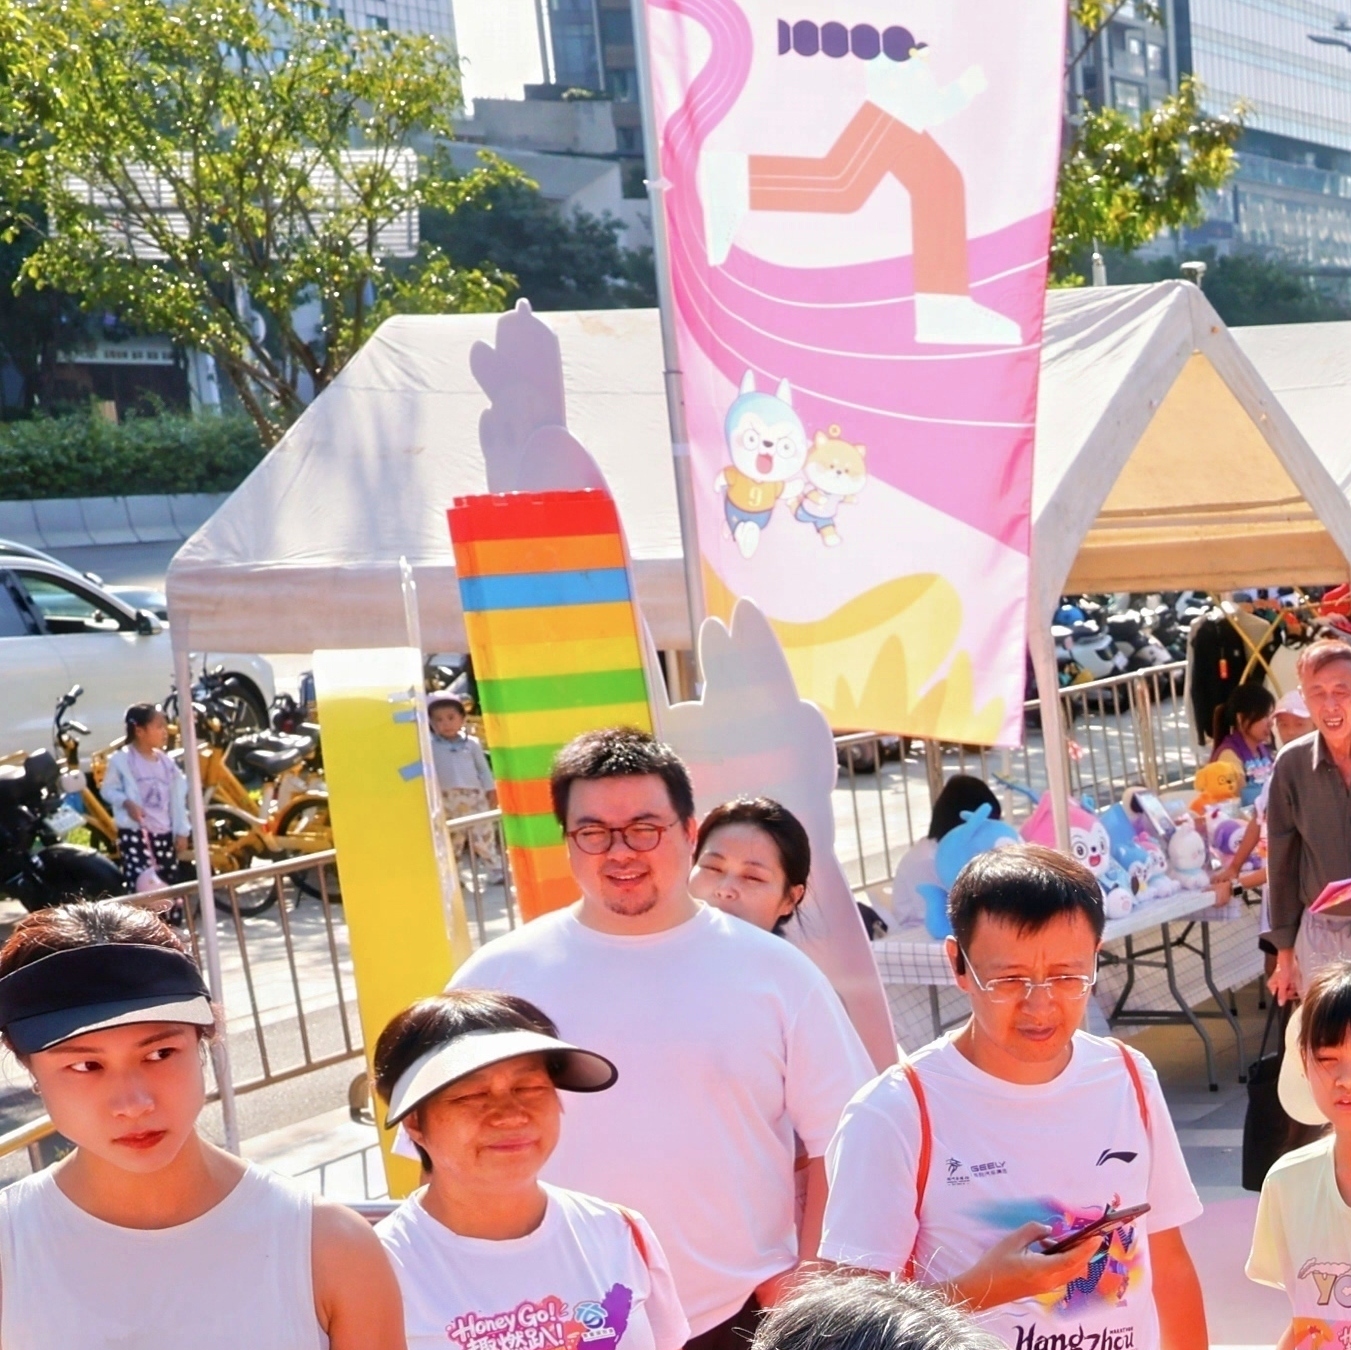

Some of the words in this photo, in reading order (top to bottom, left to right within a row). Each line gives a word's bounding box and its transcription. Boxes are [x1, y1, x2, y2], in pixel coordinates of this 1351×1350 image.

[970, 1160, 1006, 1173] GEELY
[451, 1312, 517, 1342] Honey
[517, 1301, 558, 1328] Go!
